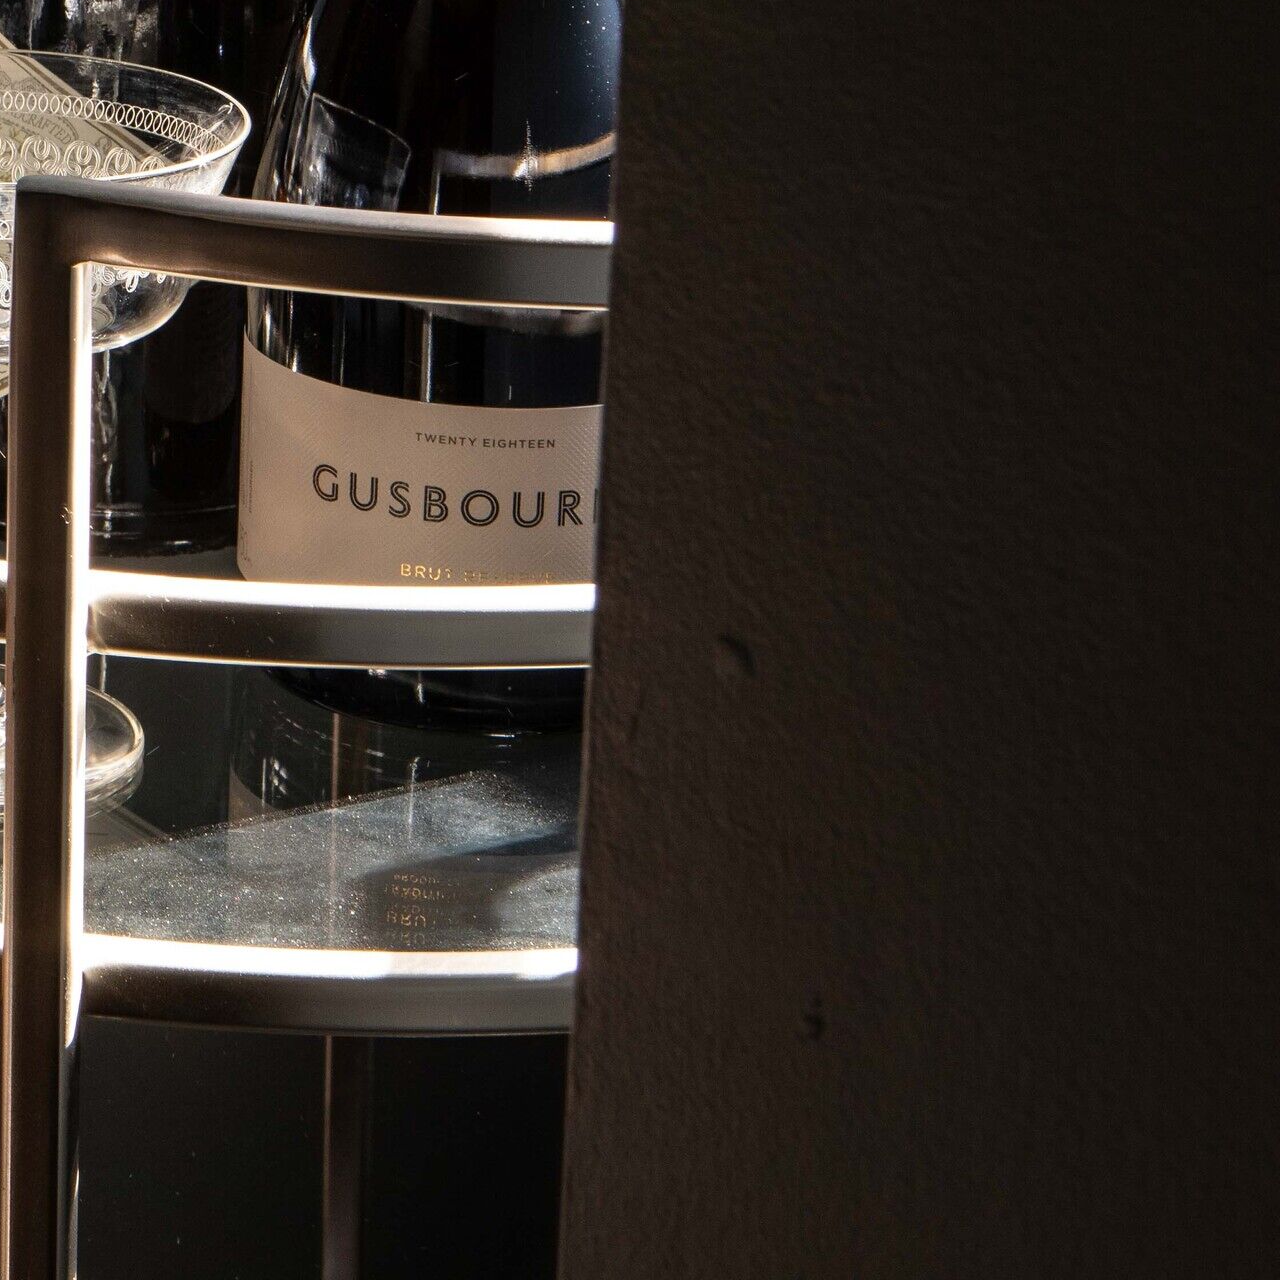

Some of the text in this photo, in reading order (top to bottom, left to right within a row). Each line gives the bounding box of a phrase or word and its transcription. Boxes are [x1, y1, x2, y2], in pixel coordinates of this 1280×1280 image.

[415, 432, 556, 449] TWENTY EIGHTEEN
[311, 462, 599, 529] GUSBOUR
